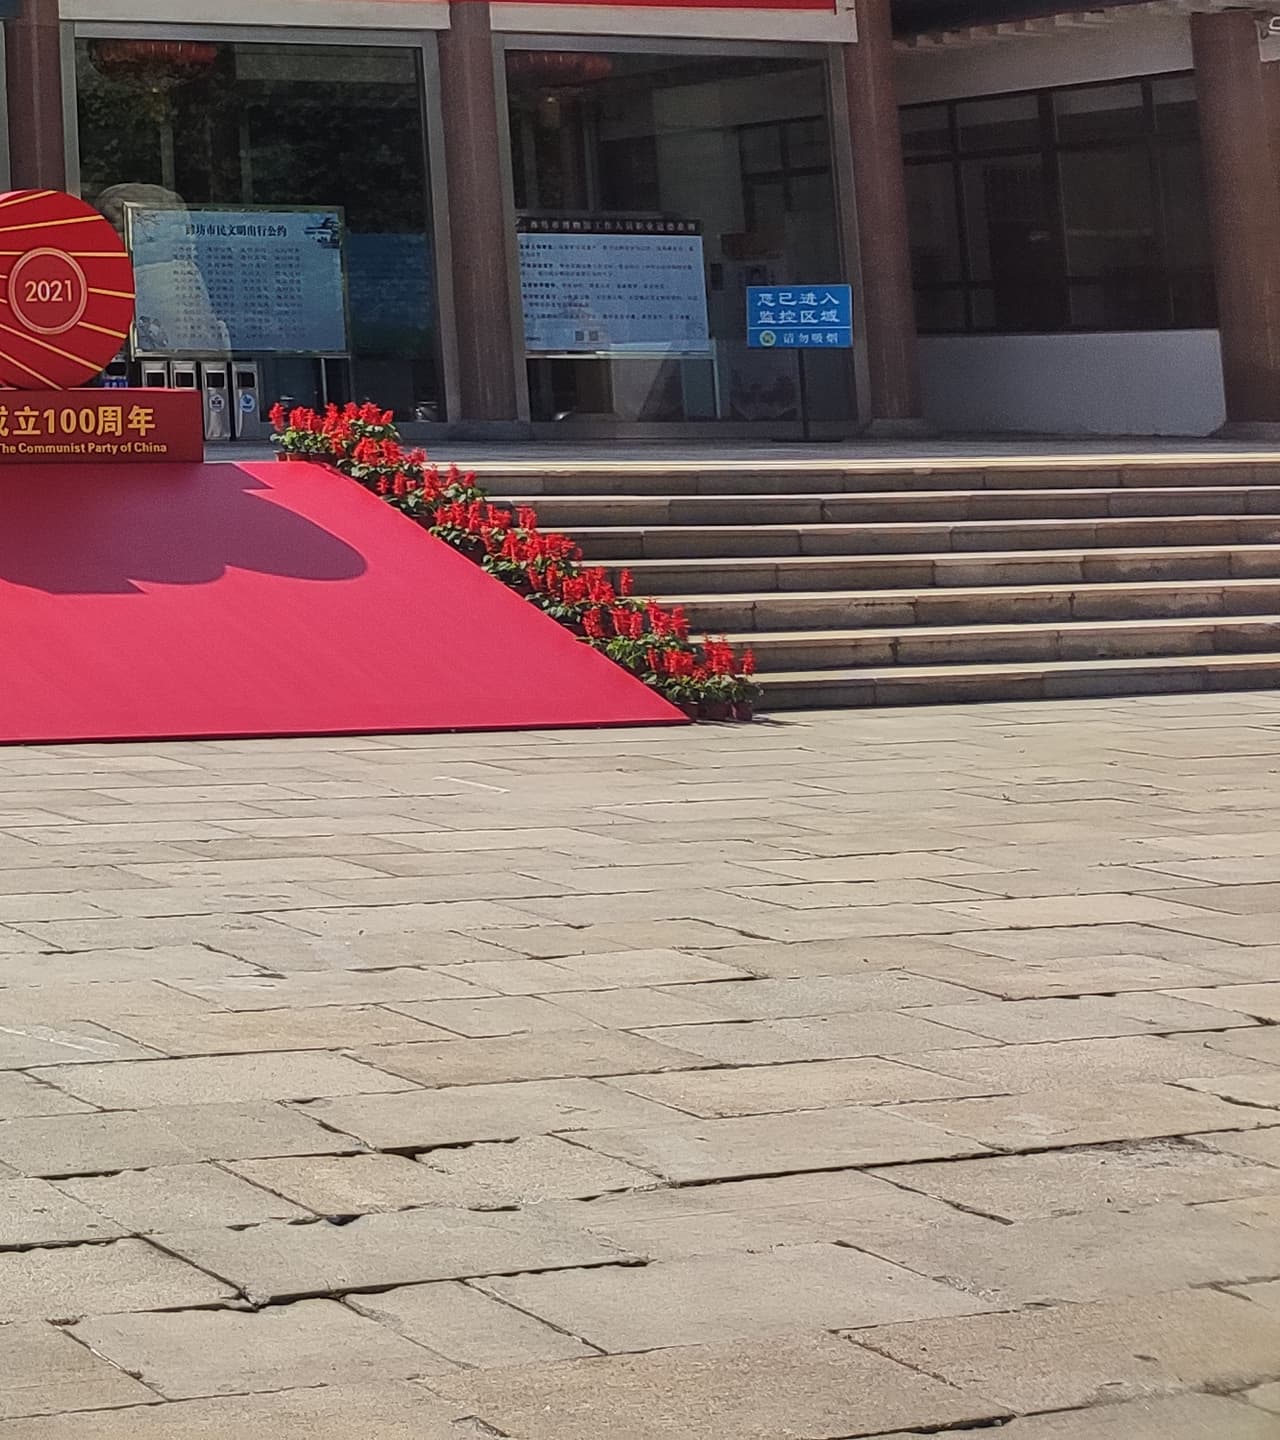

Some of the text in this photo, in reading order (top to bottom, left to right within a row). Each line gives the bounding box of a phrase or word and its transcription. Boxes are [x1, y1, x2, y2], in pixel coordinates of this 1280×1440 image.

[24, 279, 73, 302] 2021
[757, 292, 840, 307] 您已进入
[757, 309, 841, 324] 监控区域
[783, 332, 839, 344] 请勿吸烟
[18, 442, 86, 454] Communist
[88, 442, 117, 455] Party
[120, 442, 133, 453] of
[134, 442, 168, 453] China
